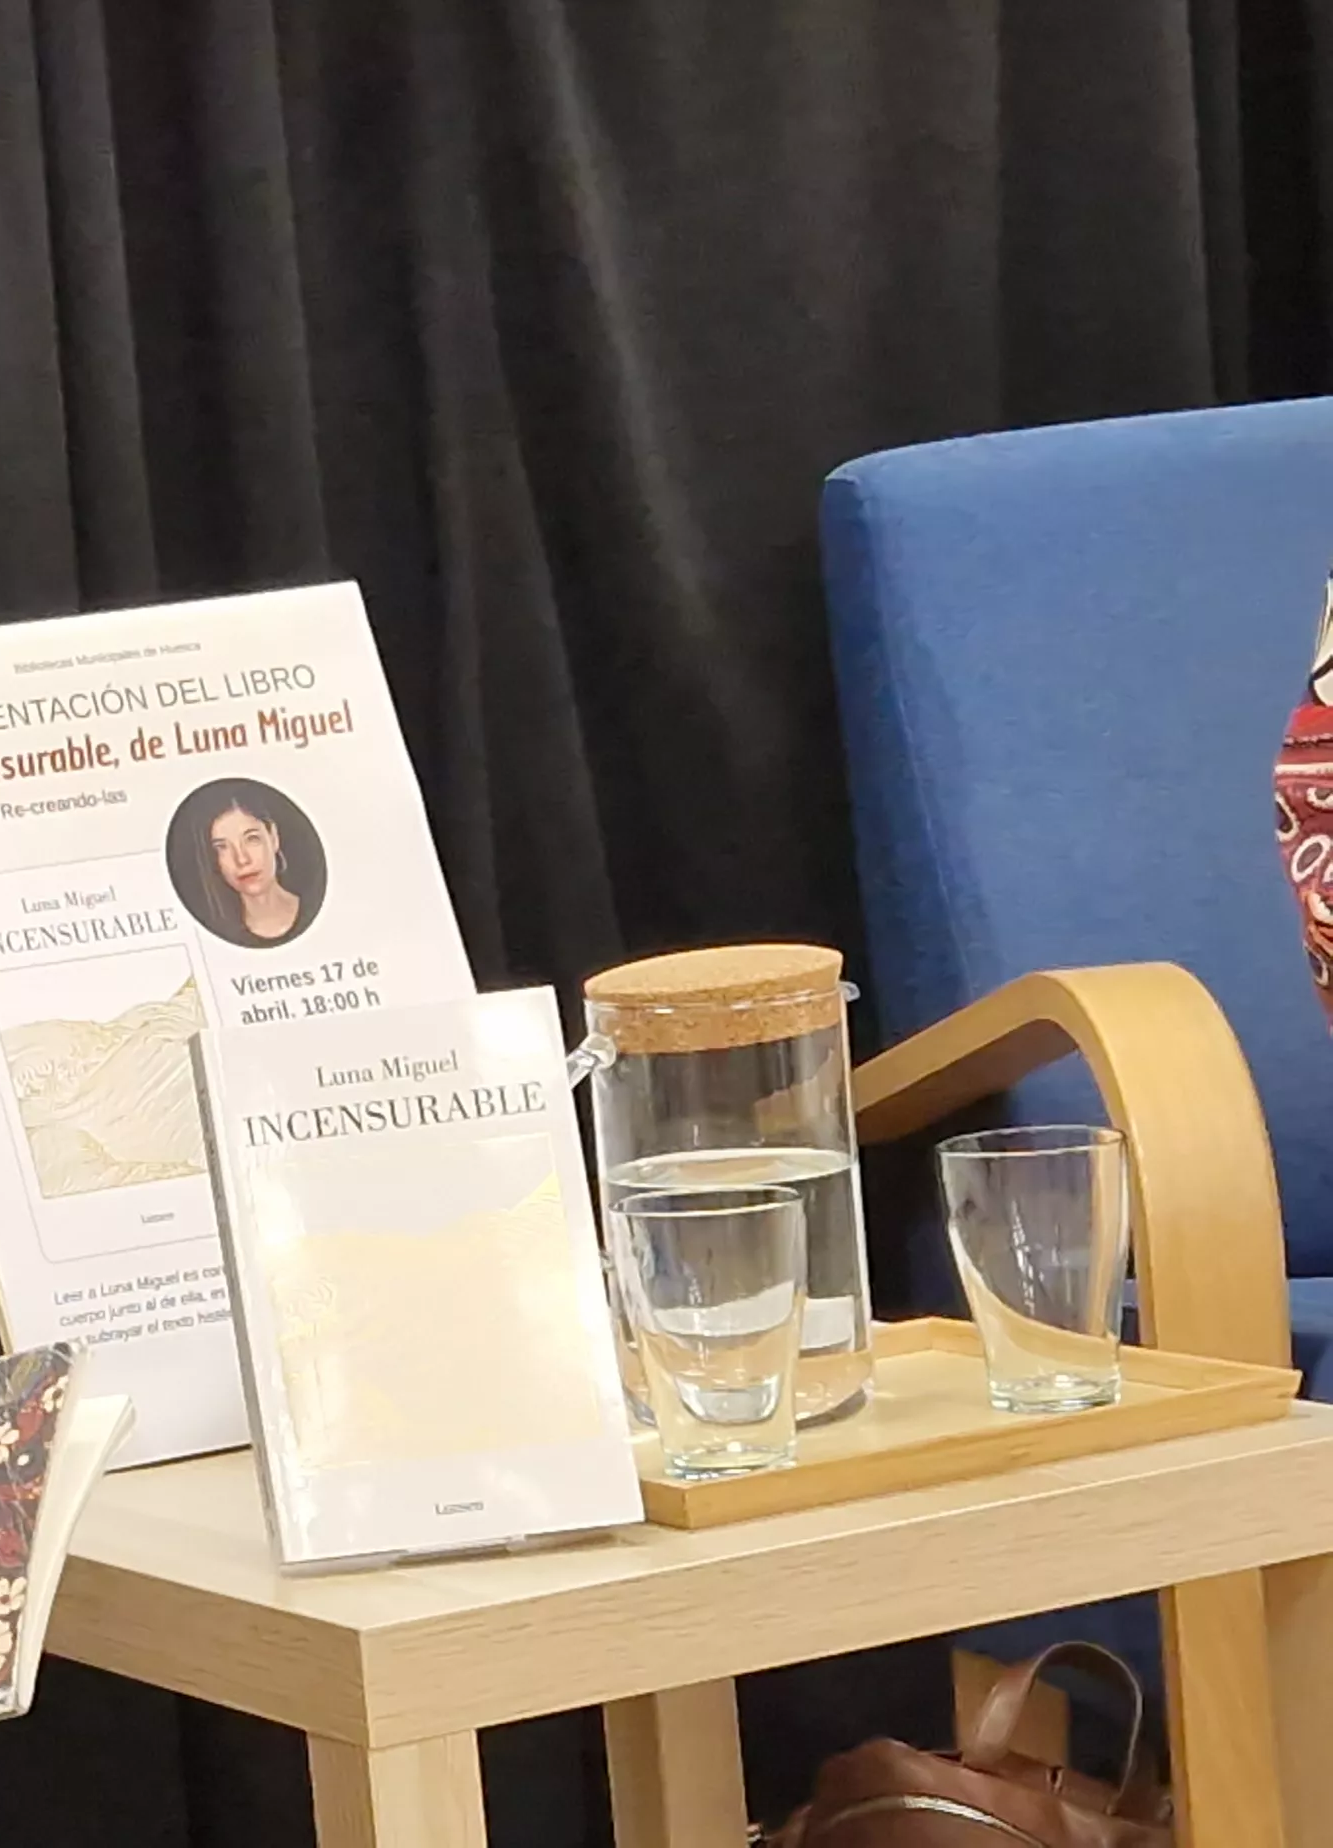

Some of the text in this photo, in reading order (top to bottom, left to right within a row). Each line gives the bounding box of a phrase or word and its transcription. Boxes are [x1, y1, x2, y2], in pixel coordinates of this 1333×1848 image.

[156, 677, 219, 708] DEL
[224, 664, 317, 699] LIBRO
[131, 727, 166, 763] de
[175, 721, 248, 755] Luna
[258, 699, 354, 749] Miguel
[0, 789, 128, 819] Re-creando-las
[21, 884, 117, 914] Luna Miguel
[231, 957, 379, 996] Viernes 17 de
[241, 986, 381, 1025] abril. 18:00 h
[315, 1049, 459, 1088] Luna Miguel
[243, 1081, 547, 1148] INCENSURABLE
[100, 1282, 134, 1298] Luna
[137, 1270, 180, 1291] Miguel
